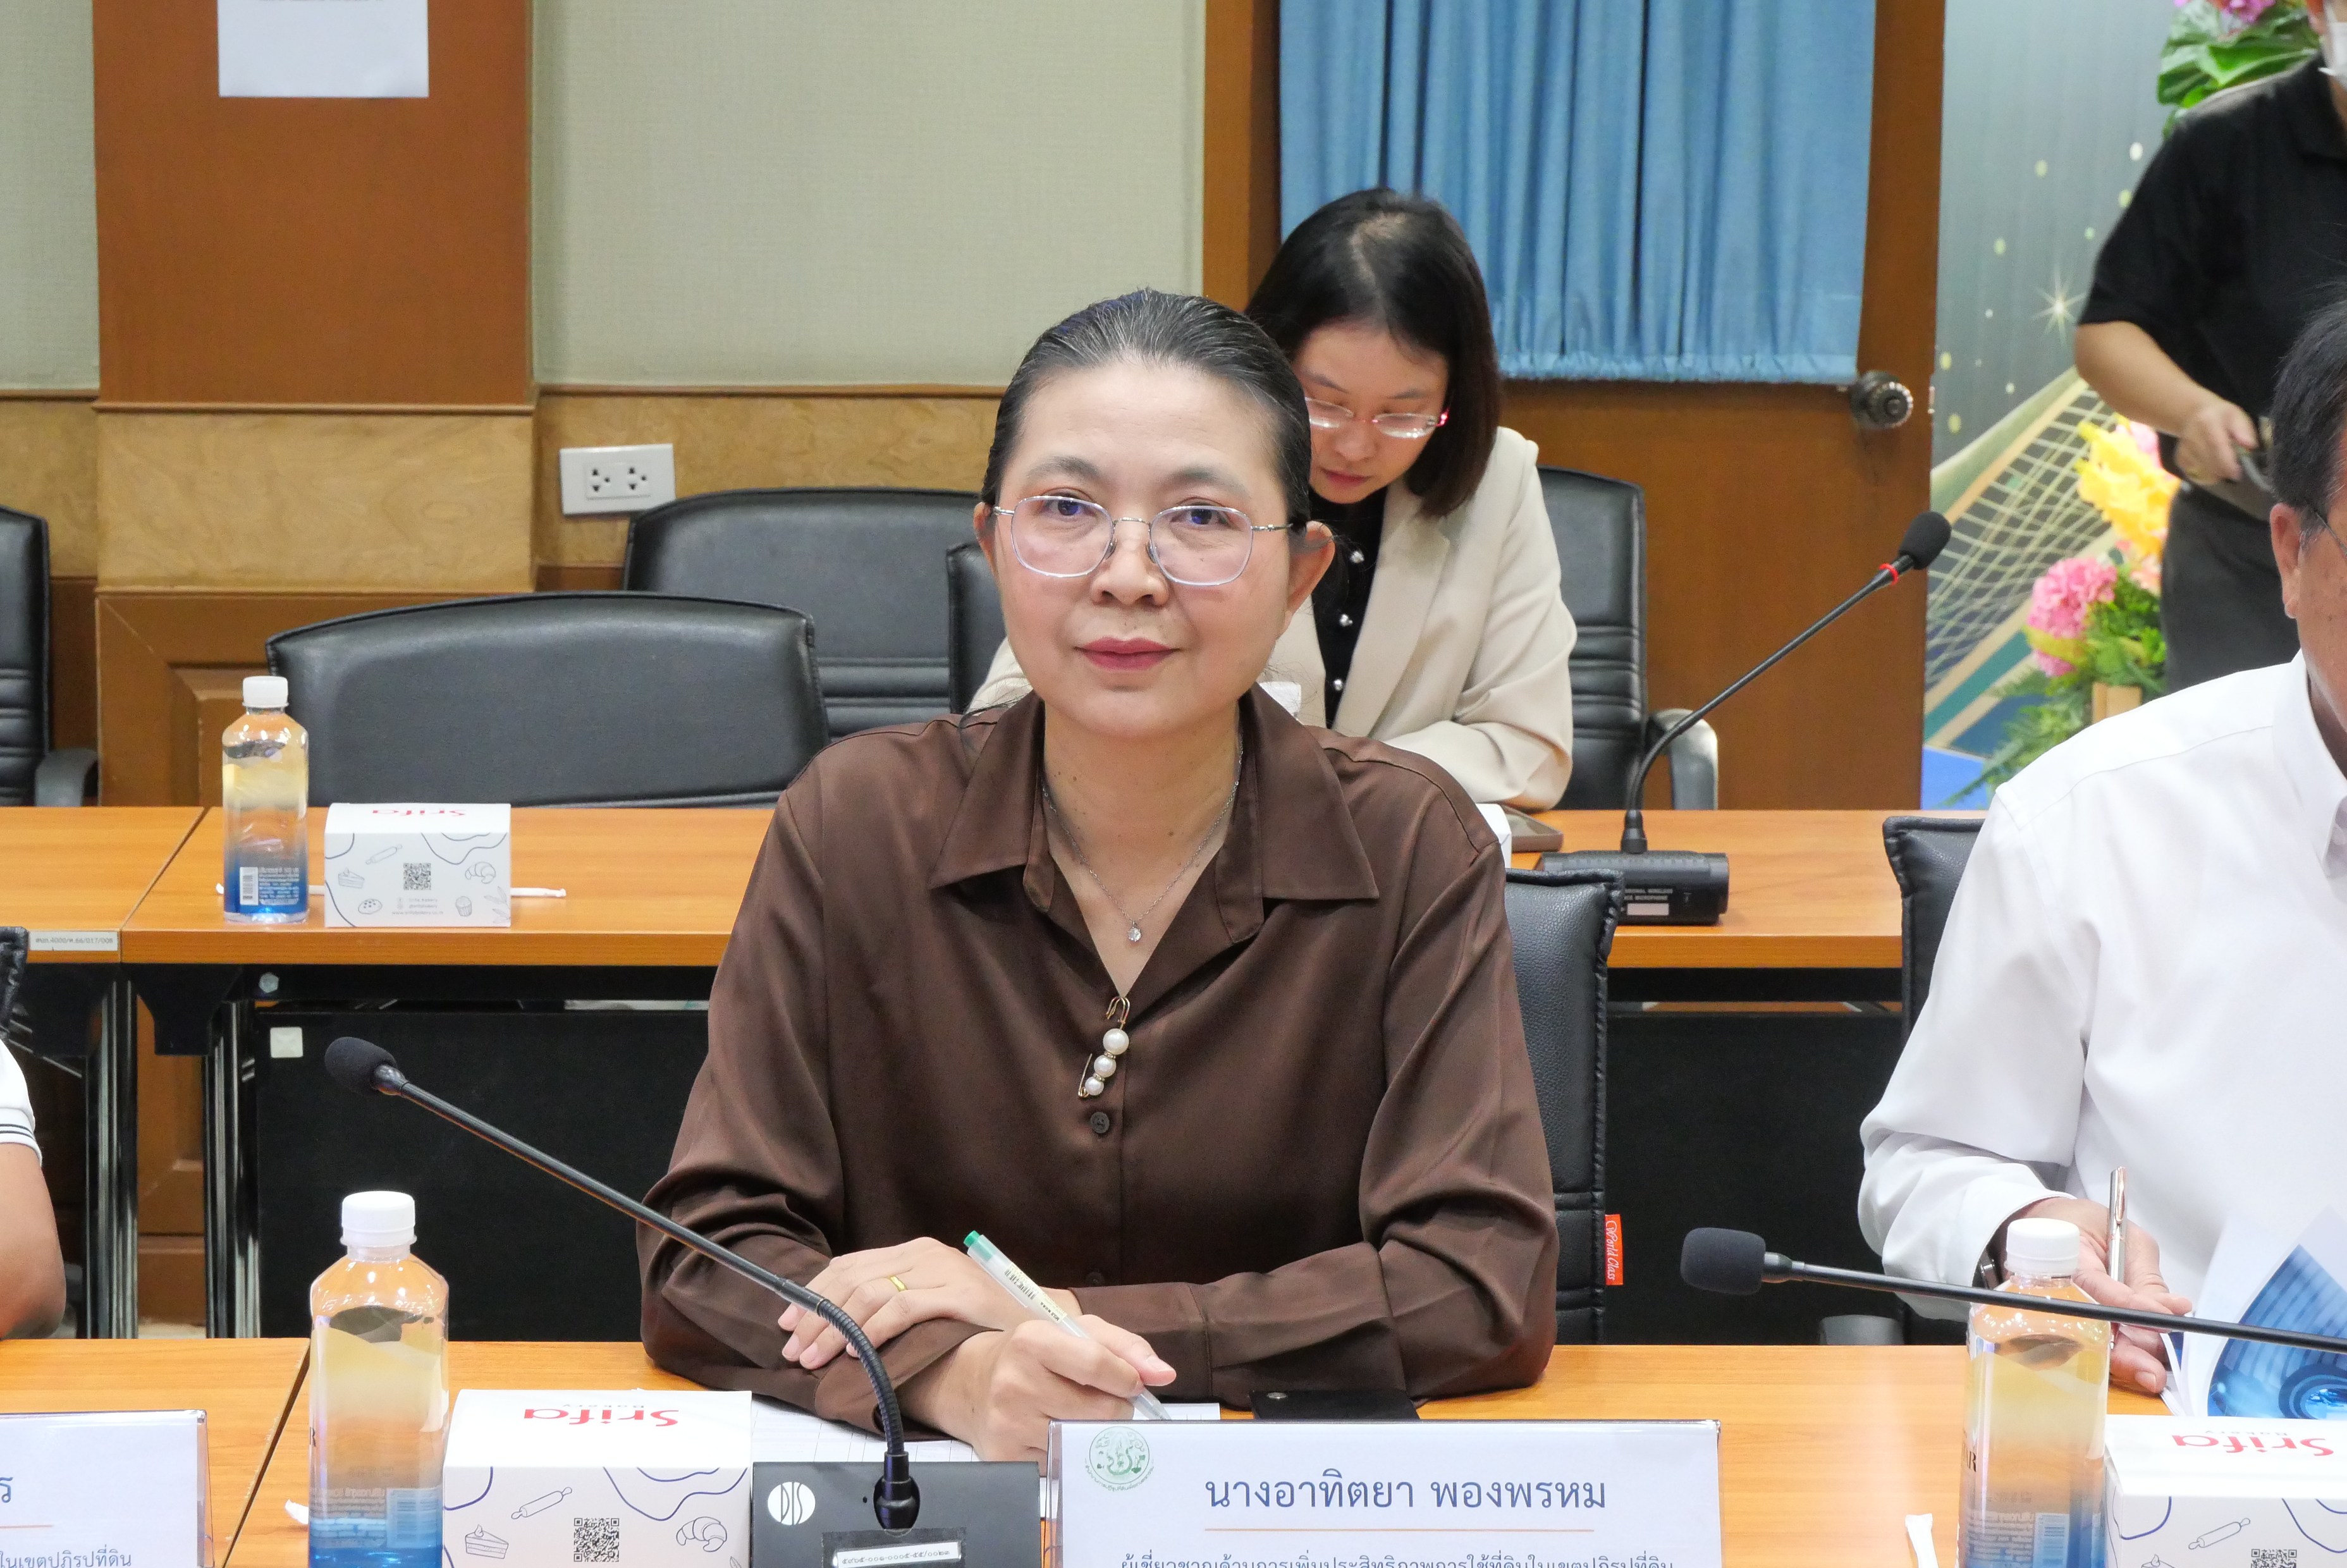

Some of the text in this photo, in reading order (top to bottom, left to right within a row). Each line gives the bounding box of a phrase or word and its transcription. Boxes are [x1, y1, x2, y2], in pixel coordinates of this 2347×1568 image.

[524, 1409, 678, 1427] Srifa
[2171, 1435, 2334, 1456] Srifa
[1205, 1468, 1605, 1509] นางอาทิตยา พองพรหม
